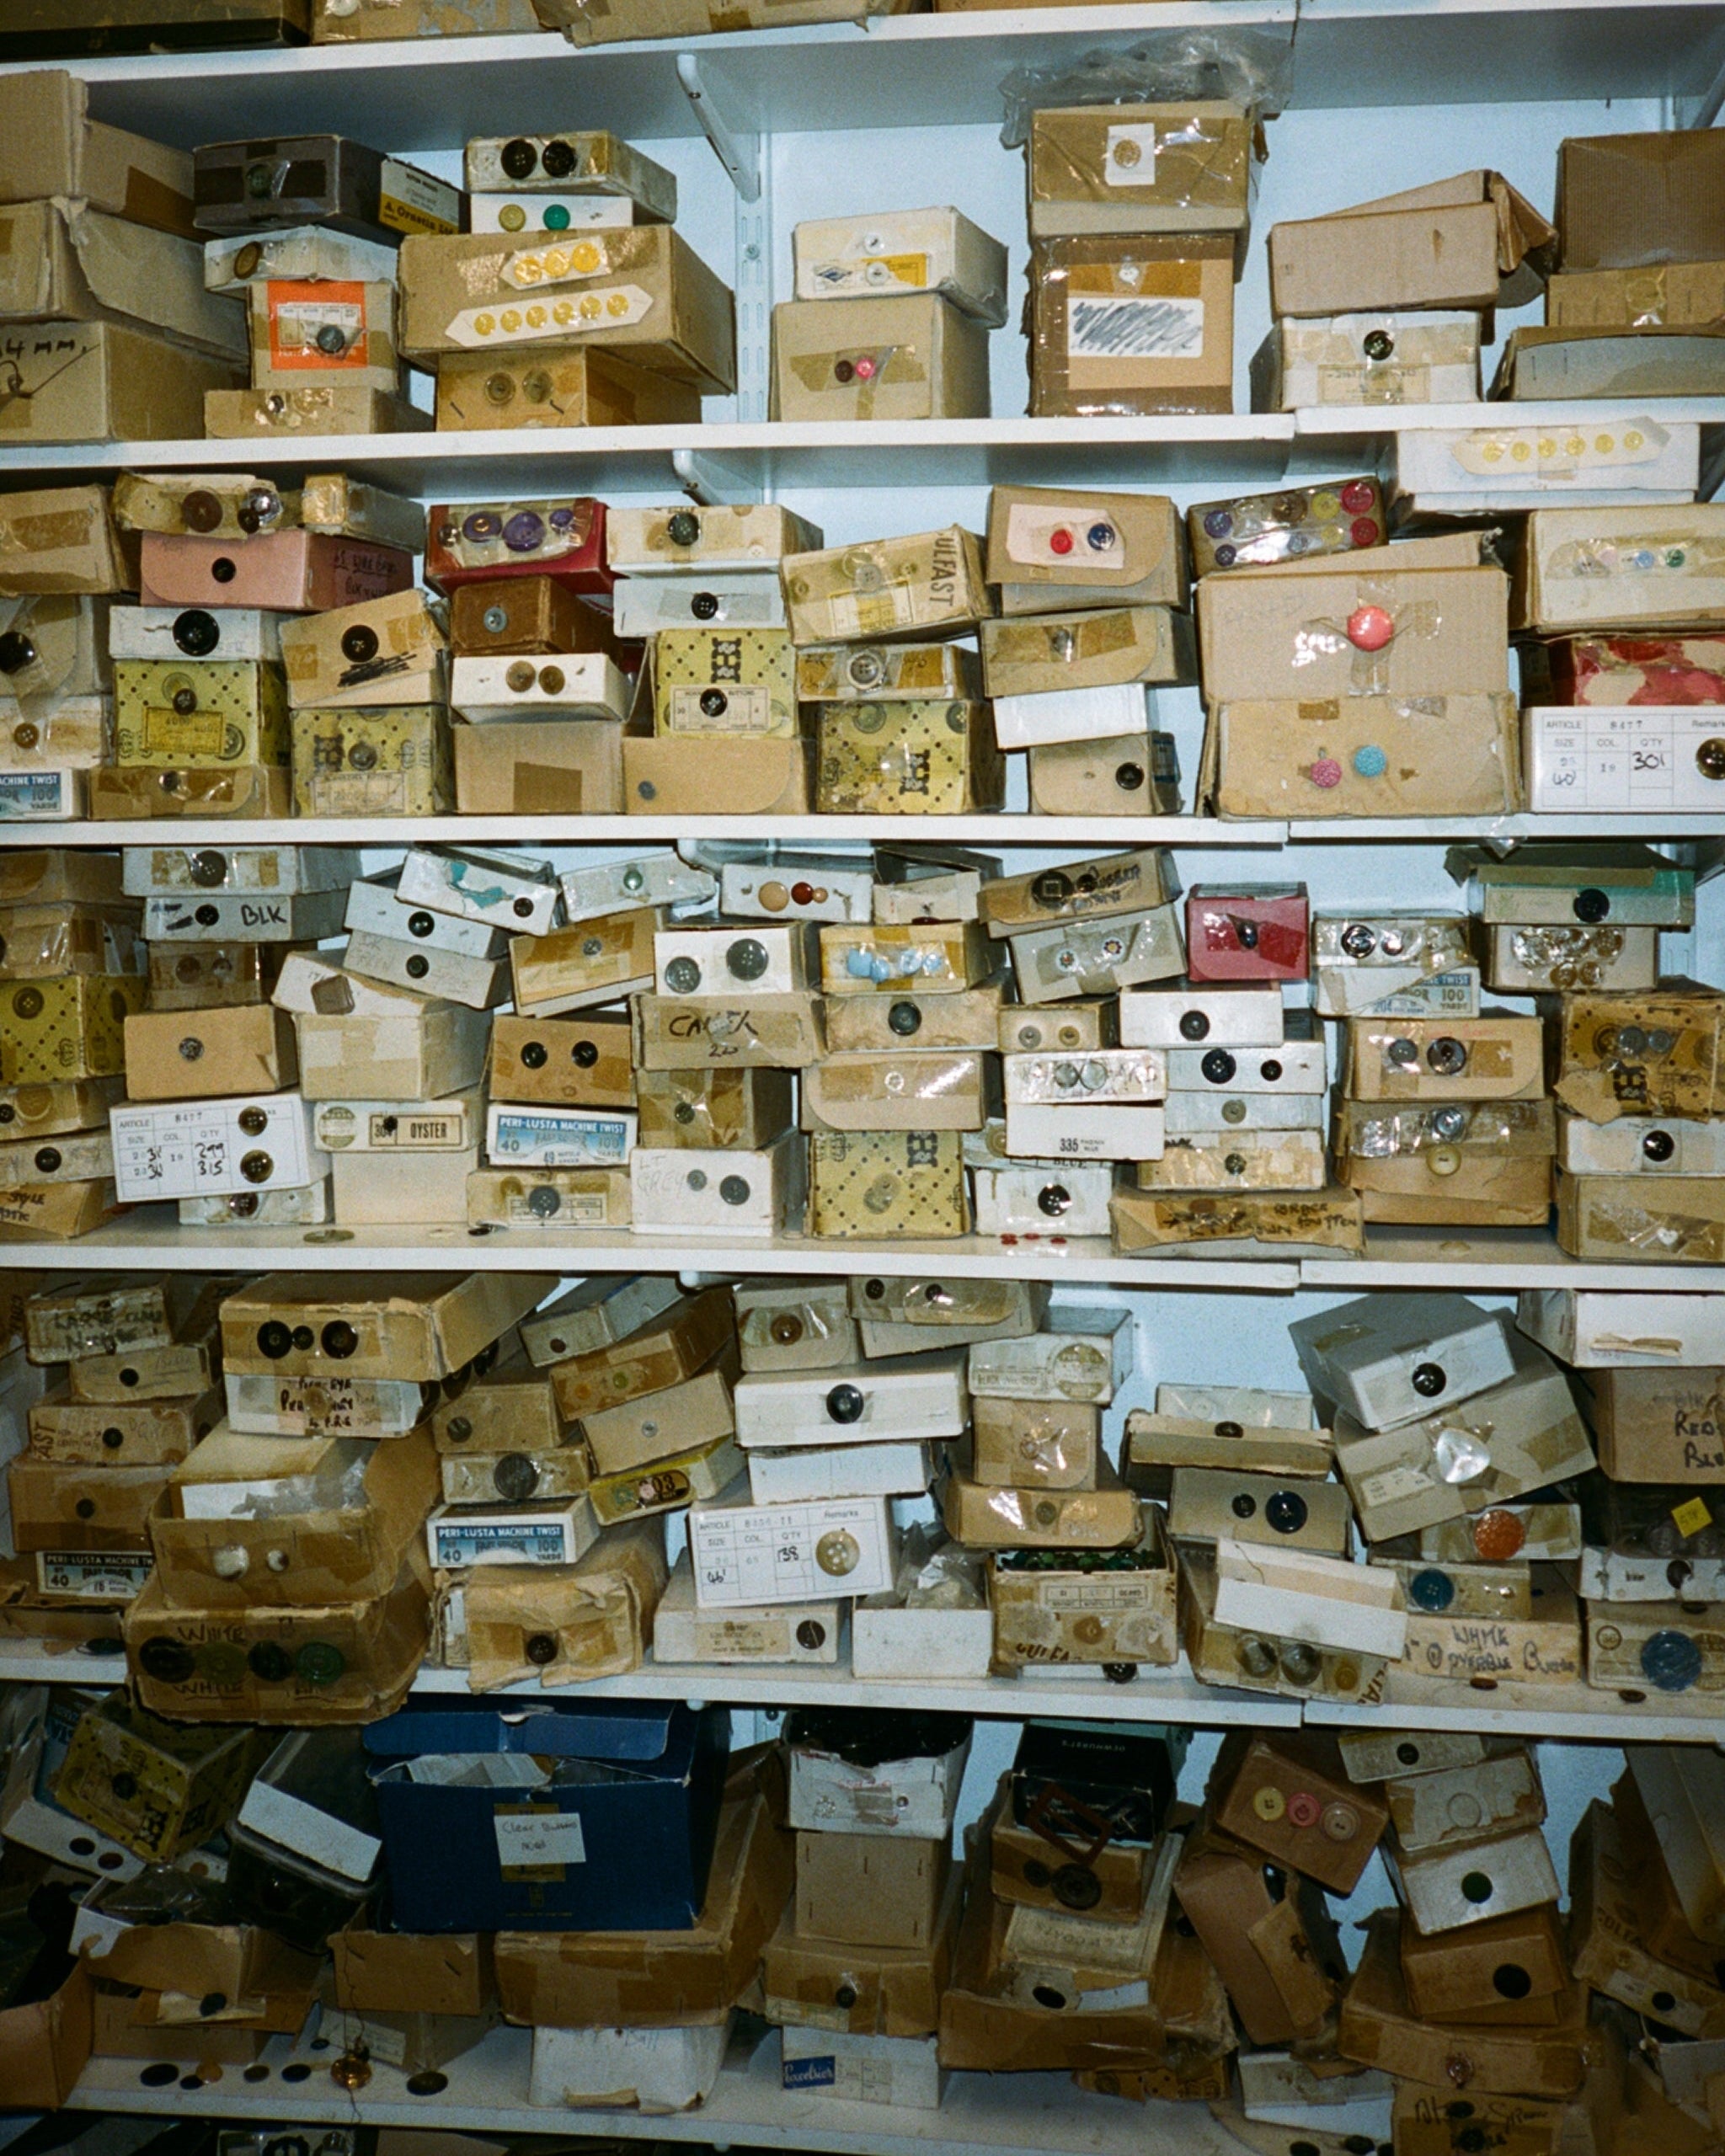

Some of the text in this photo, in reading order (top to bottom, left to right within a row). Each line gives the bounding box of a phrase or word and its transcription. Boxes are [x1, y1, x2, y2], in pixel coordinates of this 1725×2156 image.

[0, 339, 25, 360] 4
[1546, 720, 1582, 729] ARTICLE
[1691, 719, 1725, 728] Remark
[1554, 739, 1575, 748] SIZE
[0, 775, 57, 786] ACHINE TWIST
[32, 788, 55, 802] 100
[241, 904, 287, 927] BLK
[1442, 975, 1470, 985] TWIST
[1441, 989, 1466, 1001] 100
[119, 1120, 150, 1129] ARTICLE
[374, 1122, 447, 1139] 30 OYSTER
[499, 1117, 625, 1134] PERI-LUSTA MACHINE TWIST
[127, 1136, 146, 1145] SIZE
[501, 1139, 520, 1152] 40
[596, 1137, 620, 1149] 100
[1059, 1139, 1079, 1153] 335
[699, 1521, 730, 1530] ARTICLE
[438, 1527, 561, 1538] PERI-LUSTA MACHINE TWIST
[537, 1540, 558, 1552] 100
[46, 1556, 101, 1565] PERI-LUSTA
[104, 1557, 141, 1566] MACHINE
[442, 1550, 462, 1562] 40
[51, 1575, 69, 1587] 40
[177, 1623, 247, 1643] WHITE
[502, 1820, 535, 1834] Clear
